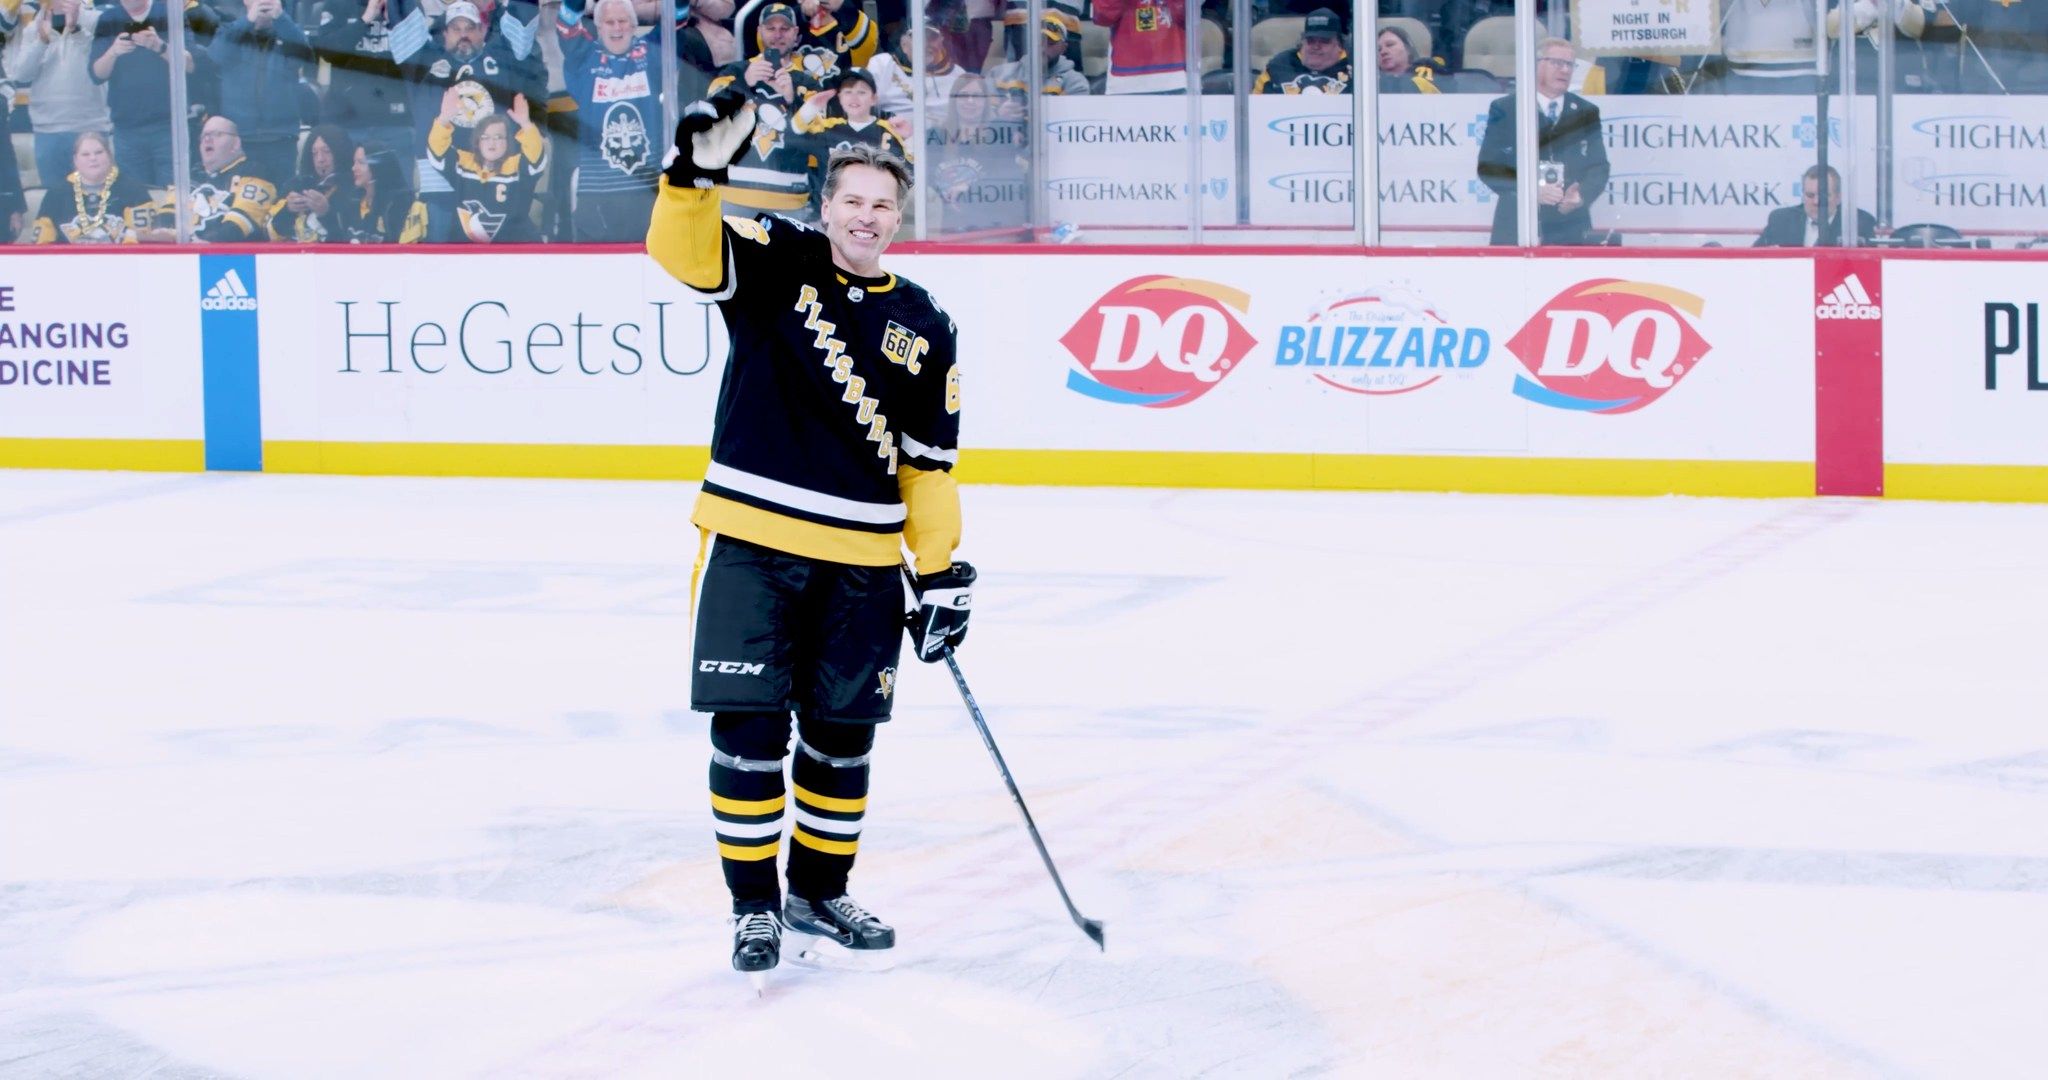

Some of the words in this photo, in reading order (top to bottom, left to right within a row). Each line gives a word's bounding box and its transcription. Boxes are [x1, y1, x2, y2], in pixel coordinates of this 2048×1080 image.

[1613, 13, 1649, 25] NIGHT
[1658, 12, 1670, 24] IN
[1611, 28, 1686, 41] PITTSBURGH
[1058, 125, 1177, 143] HIGHMARK
[1608, 124, 1782, 149] HIGHMARK
[1058, 183, 1177, 201] HIGHMARK
[1608, 181, 1782, 206] HIGHMARK
[202, 295, 258, 311] adidas
[1815, 301, 1882, 320] adidas
[0, 322, 129, 349] ANGING
[886, 331, 909, 359] 68
[1090, 304, 1230, 382] DQ
[1275, 325, 1491, 369] BLIZZARD
[1985, 302, 2048, 391] PL
[907, 336, 930, 376] C
[1537, 308, 1683, 389] DQ
[0, 360, 111, 386] DICINE
[699, 659, 766, 676] CCM
